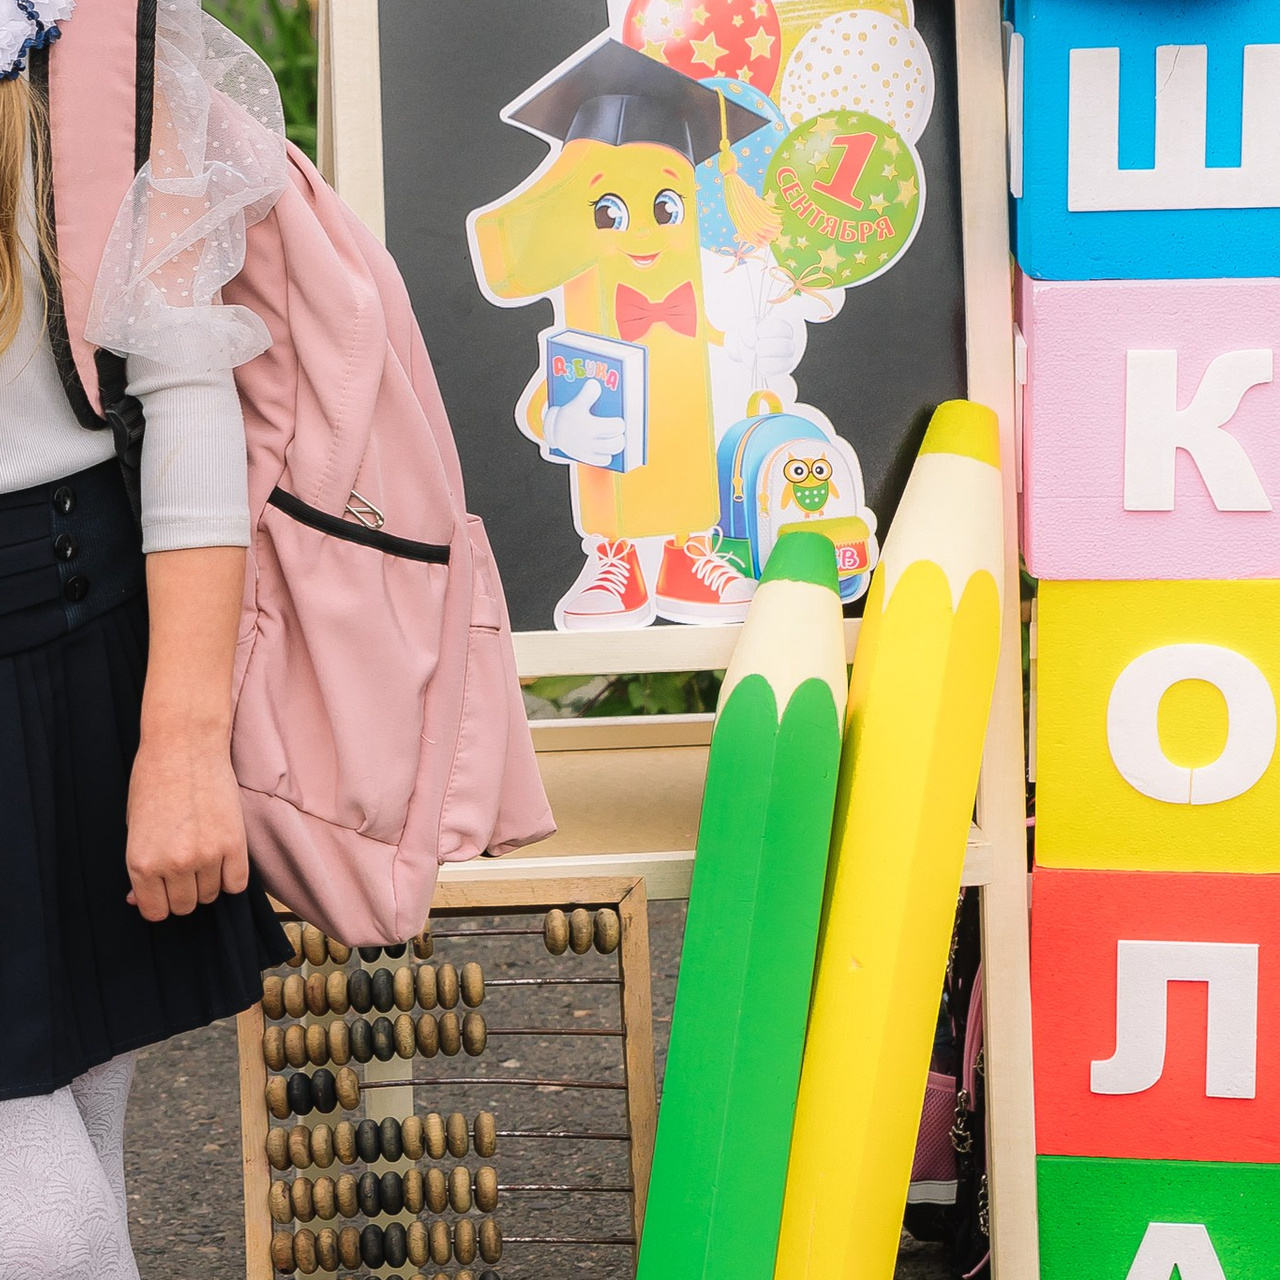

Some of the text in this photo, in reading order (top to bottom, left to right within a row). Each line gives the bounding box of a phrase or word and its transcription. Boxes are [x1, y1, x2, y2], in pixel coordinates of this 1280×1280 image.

[811, 131, 878, 211] 1
[776, 166, 895, 244] СЕНТЯБРЯ
[552, 355, 619, 392] АЗБУКА
[835, 547, 859, 569] В
